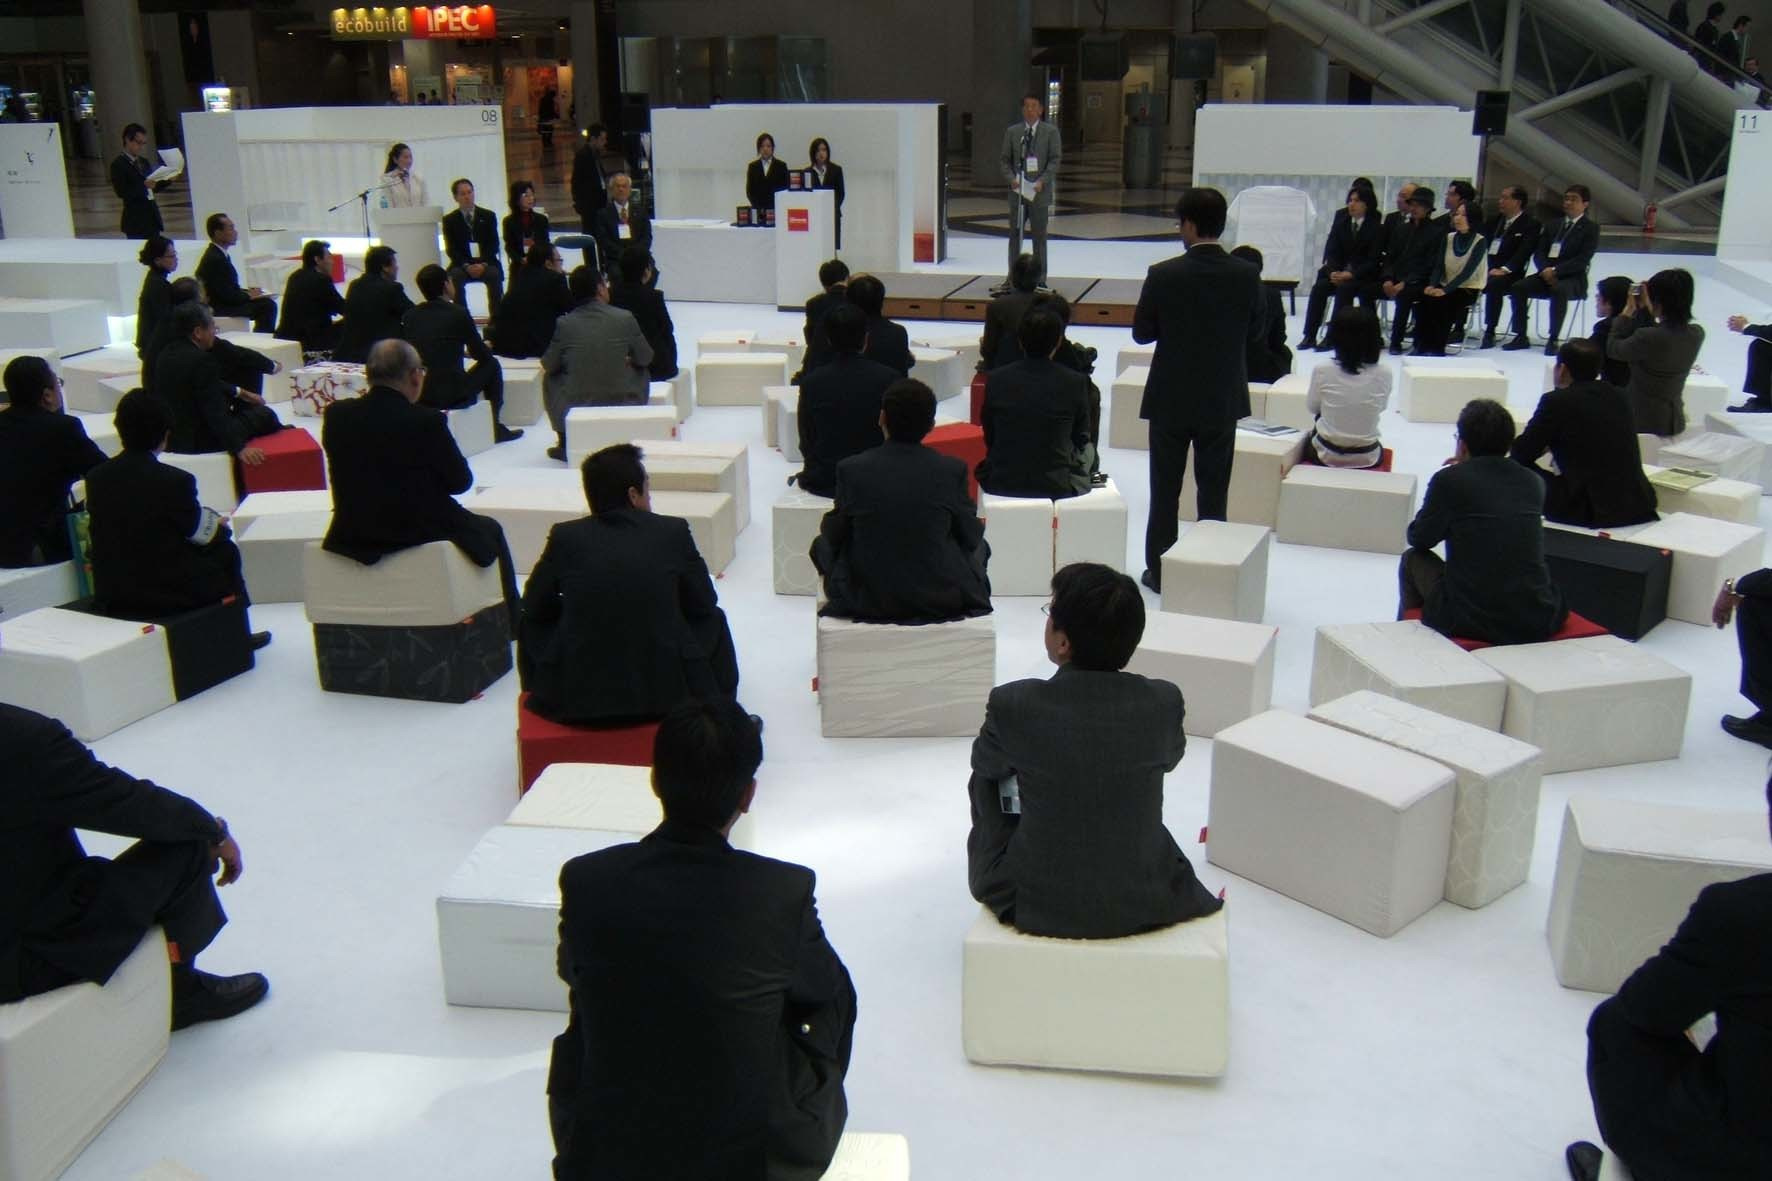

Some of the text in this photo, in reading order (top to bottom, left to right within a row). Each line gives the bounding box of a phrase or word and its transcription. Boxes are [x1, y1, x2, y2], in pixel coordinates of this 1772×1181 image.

[335, 16, 407, 33] ecobuild
[426, 8, 480, 32] IPEC
[481, 109, 498, 122] 08
[1740, 115, 1757, 129] 11
